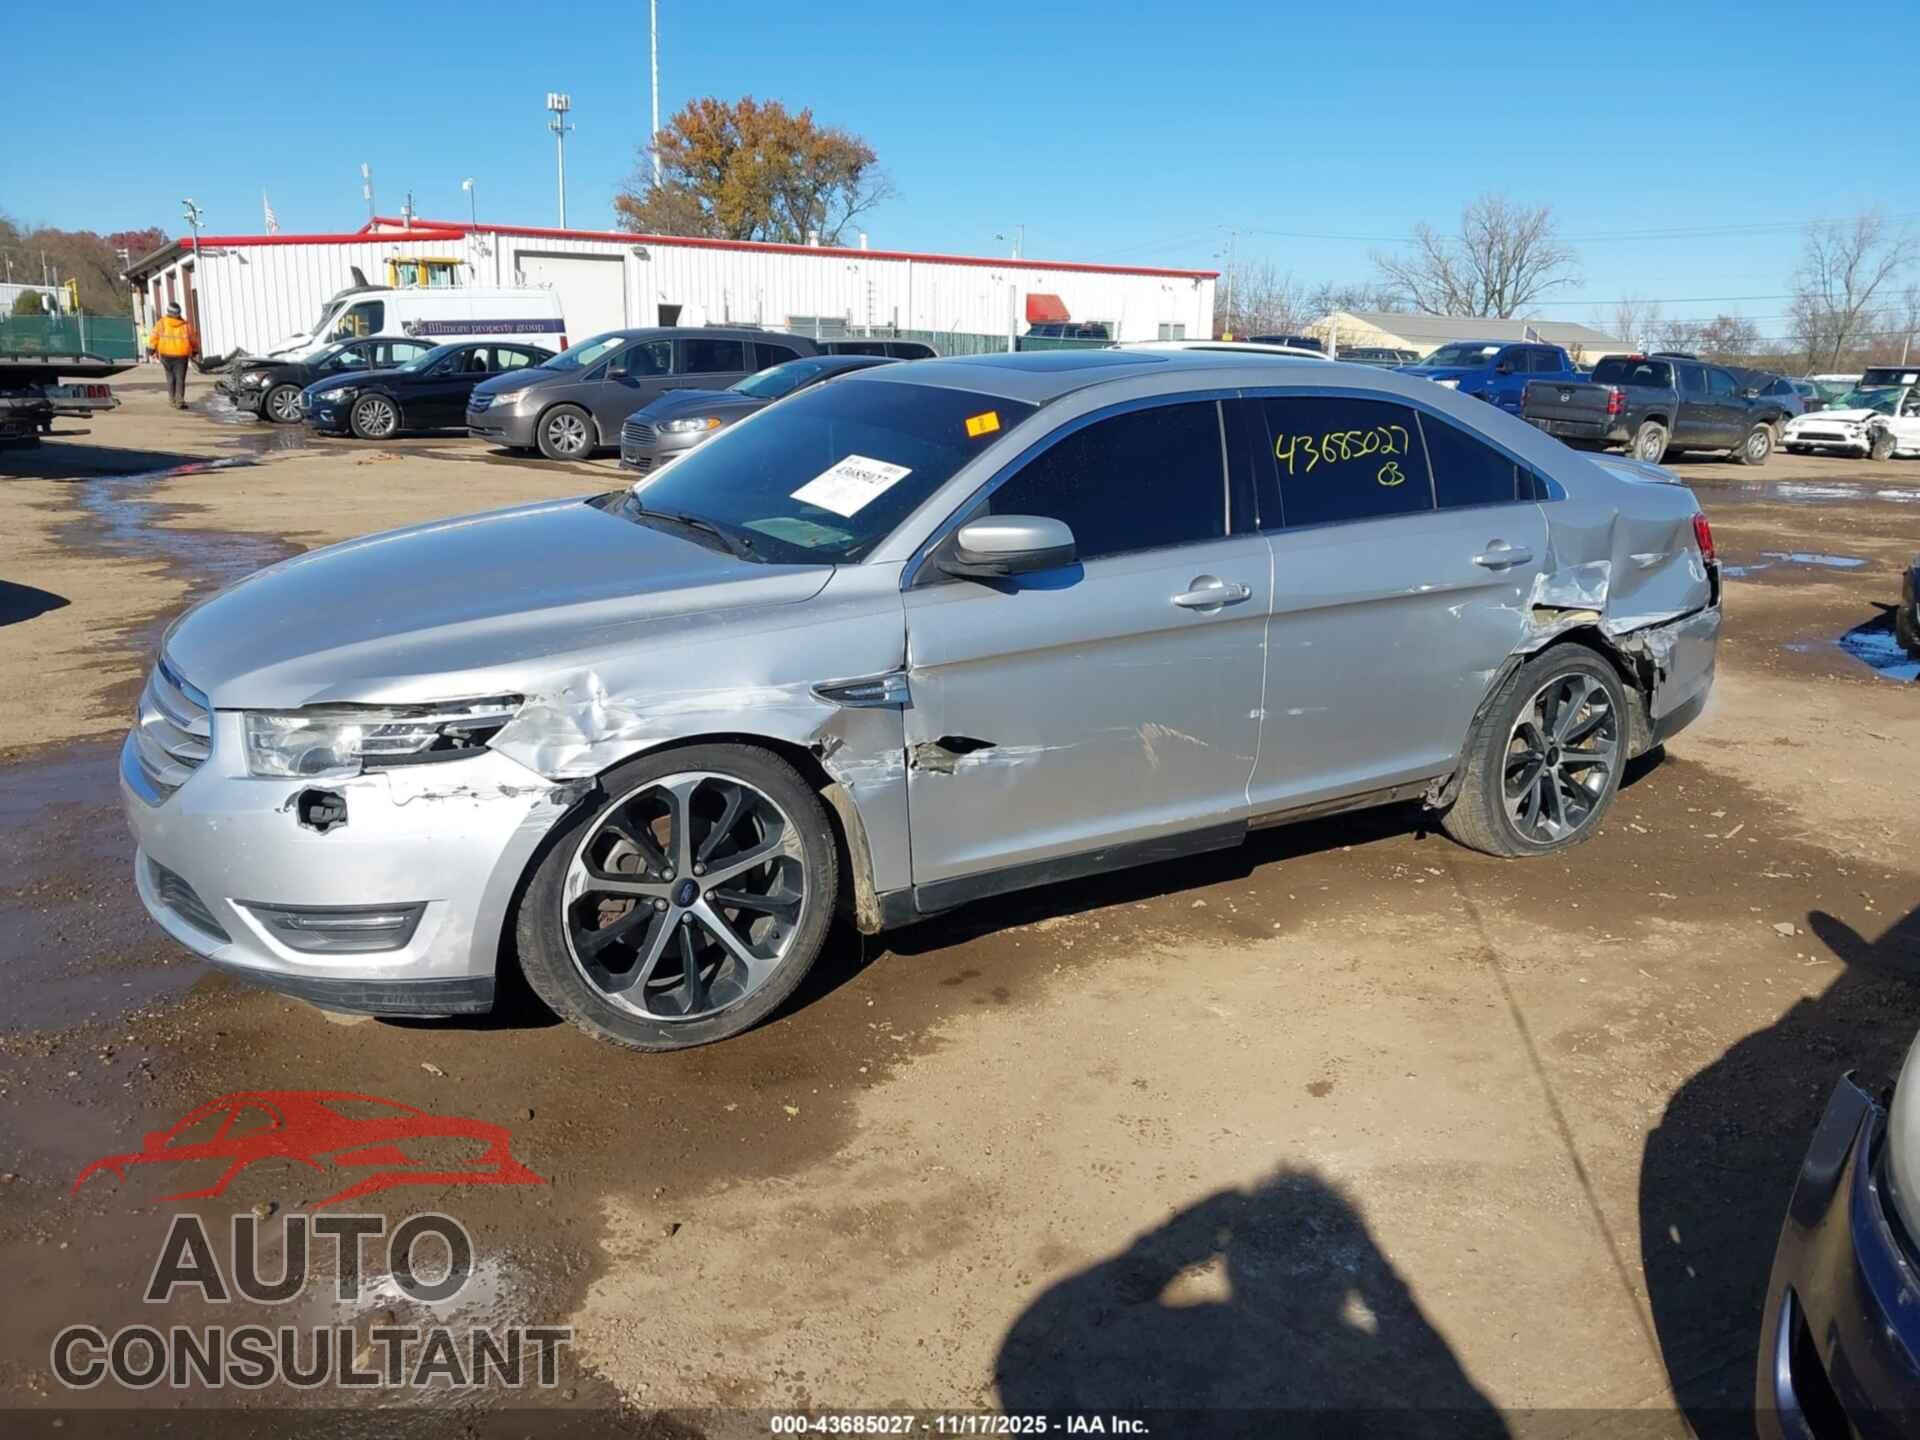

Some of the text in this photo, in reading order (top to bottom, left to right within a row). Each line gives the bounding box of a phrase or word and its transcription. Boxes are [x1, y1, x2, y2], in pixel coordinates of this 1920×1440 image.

[472, 323, 513, 334] property
[516, 324, 545, 334] group
[1275, 425, 1409, 475] 43685027
